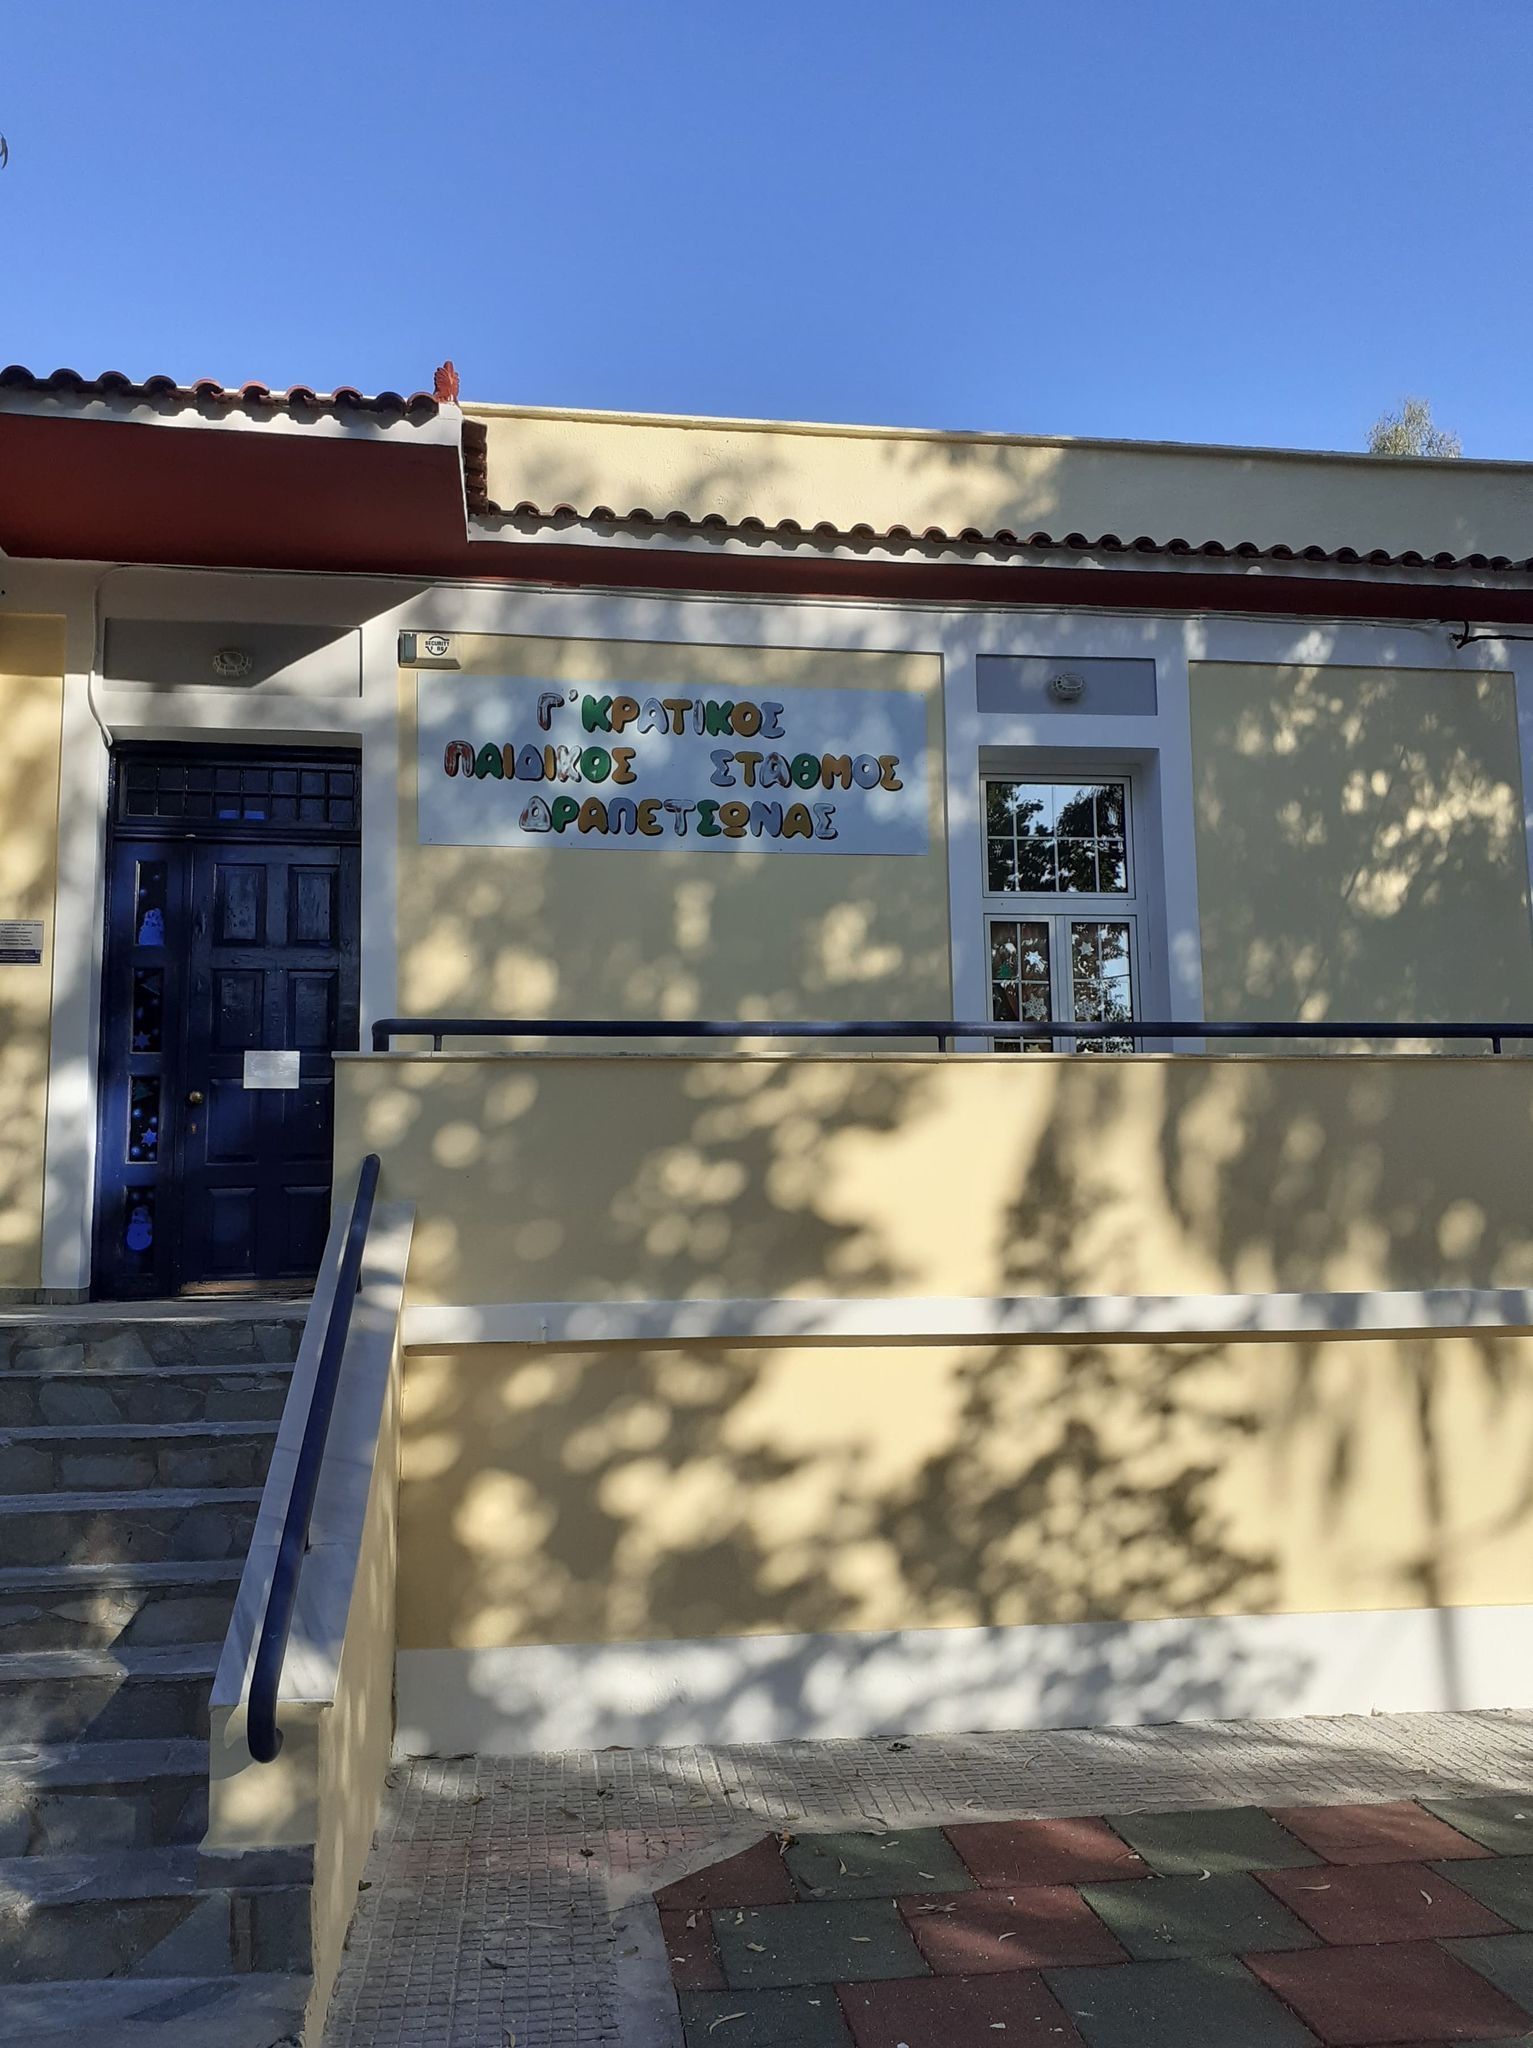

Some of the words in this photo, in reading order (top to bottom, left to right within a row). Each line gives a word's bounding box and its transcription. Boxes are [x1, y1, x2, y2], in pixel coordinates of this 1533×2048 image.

[581, 694, 786, 739] ΚΡΑΤΙΚΟΣ
[444, 740, 637, 785] ΠΑΙΔΙΚΟΣ
[709, 749, 903, 791] ΣΤΑΘΜΟΣ
[518, 795, 838, 839] ΔΡΑΠΕΤΣΩΝΑΣ
